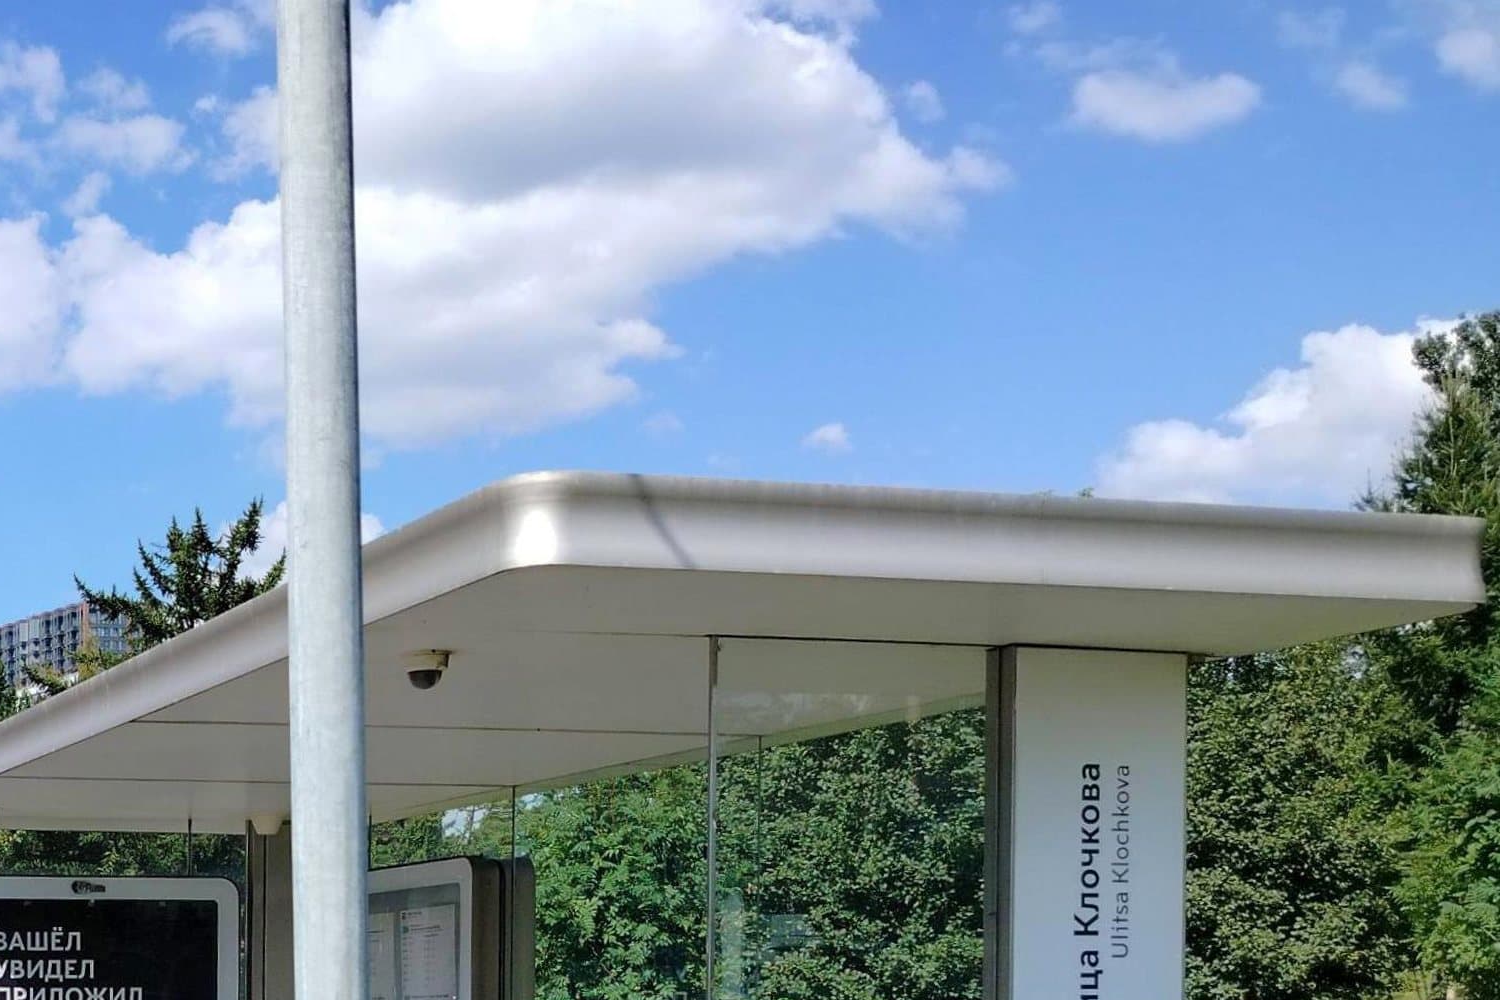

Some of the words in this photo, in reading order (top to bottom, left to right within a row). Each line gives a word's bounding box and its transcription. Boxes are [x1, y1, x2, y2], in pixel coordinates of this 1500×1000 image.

[1073, 763, 1101, 936] Клочкова
[1111, 765, 1130, 883] Klochkova
[1111, 892, 1129, 959] Ulitsa
